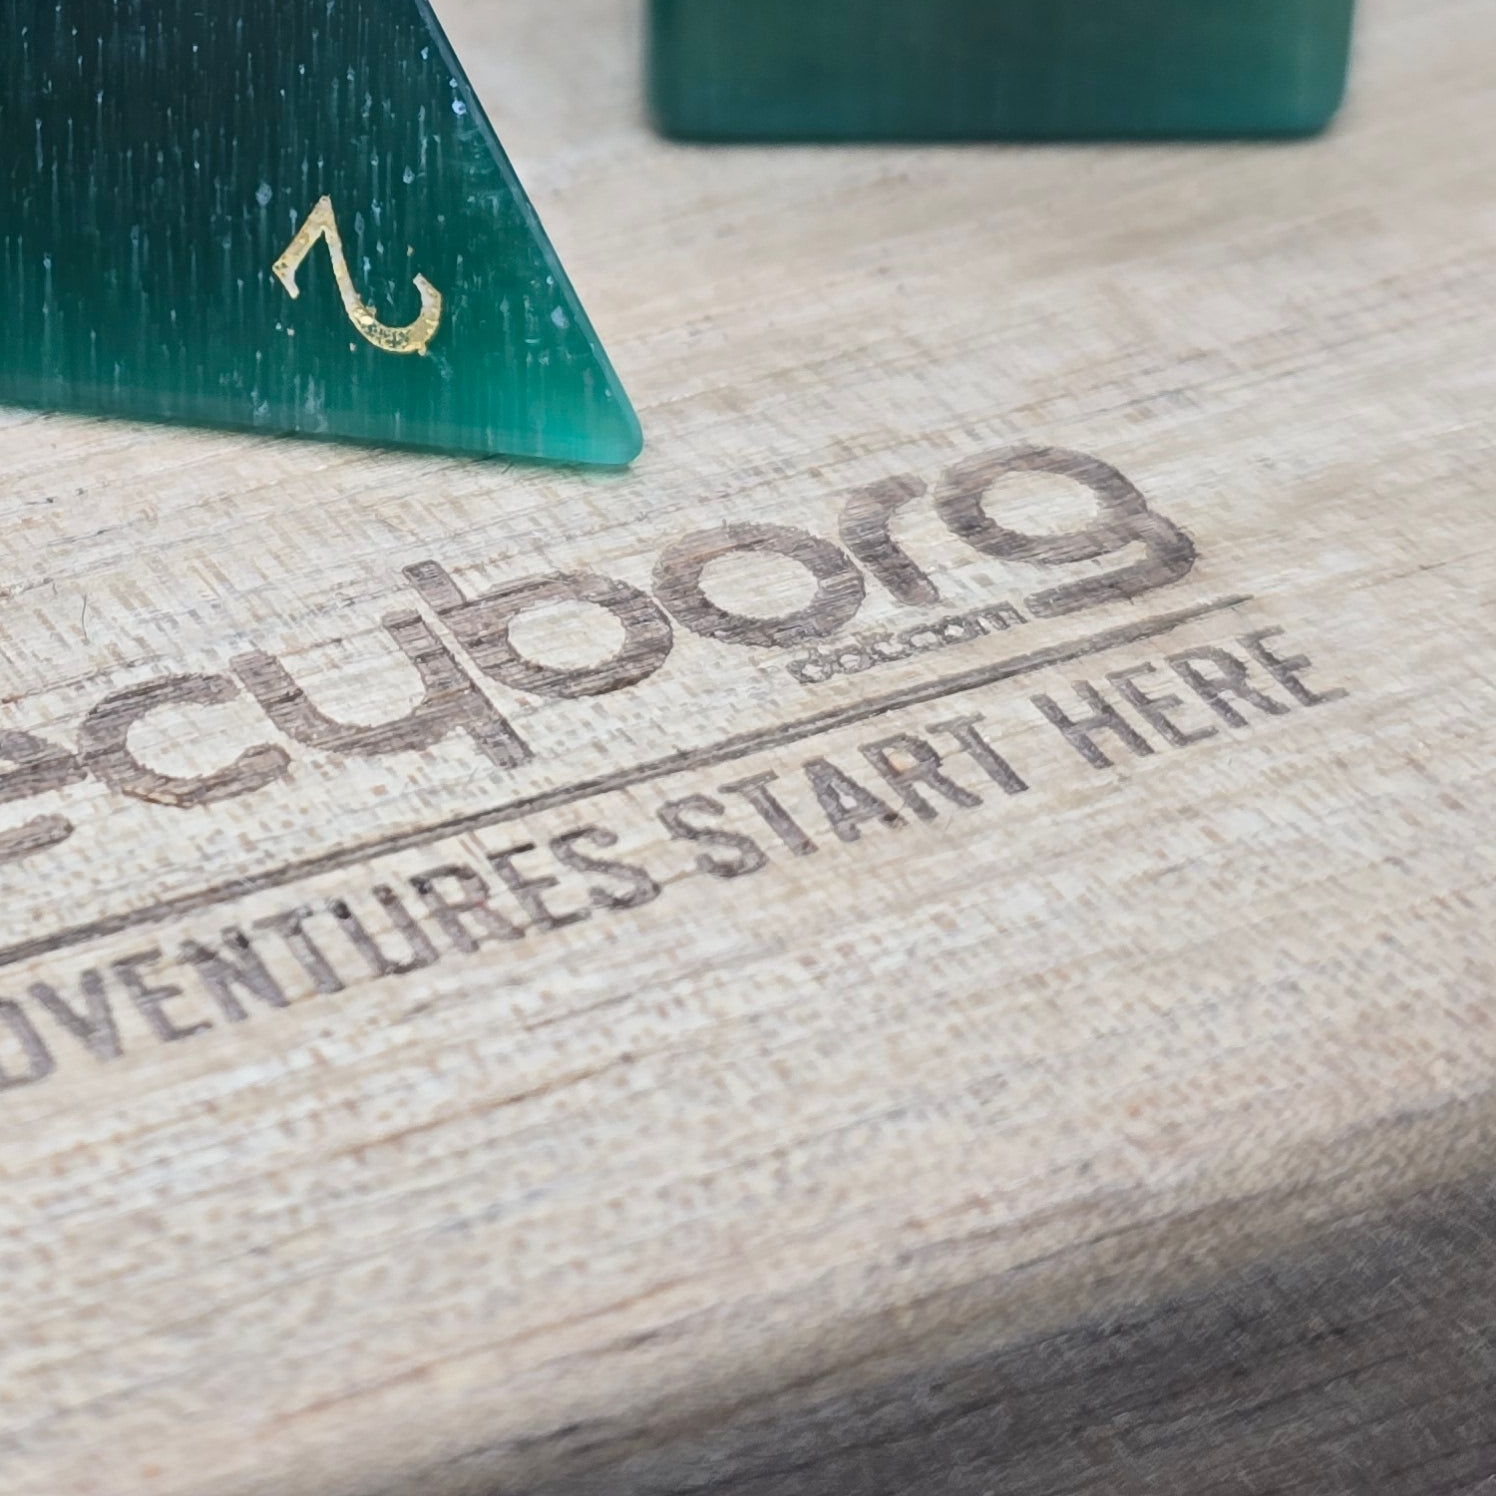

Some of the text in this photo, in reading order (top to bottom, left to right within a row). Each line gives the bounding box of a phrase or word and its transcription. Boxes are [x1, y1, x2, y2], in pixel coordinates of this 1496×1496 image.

[272, 195, 442, 355] 2
[659, 713, 1031, 879] START
[1031, 625, 1348, 768] HERE
